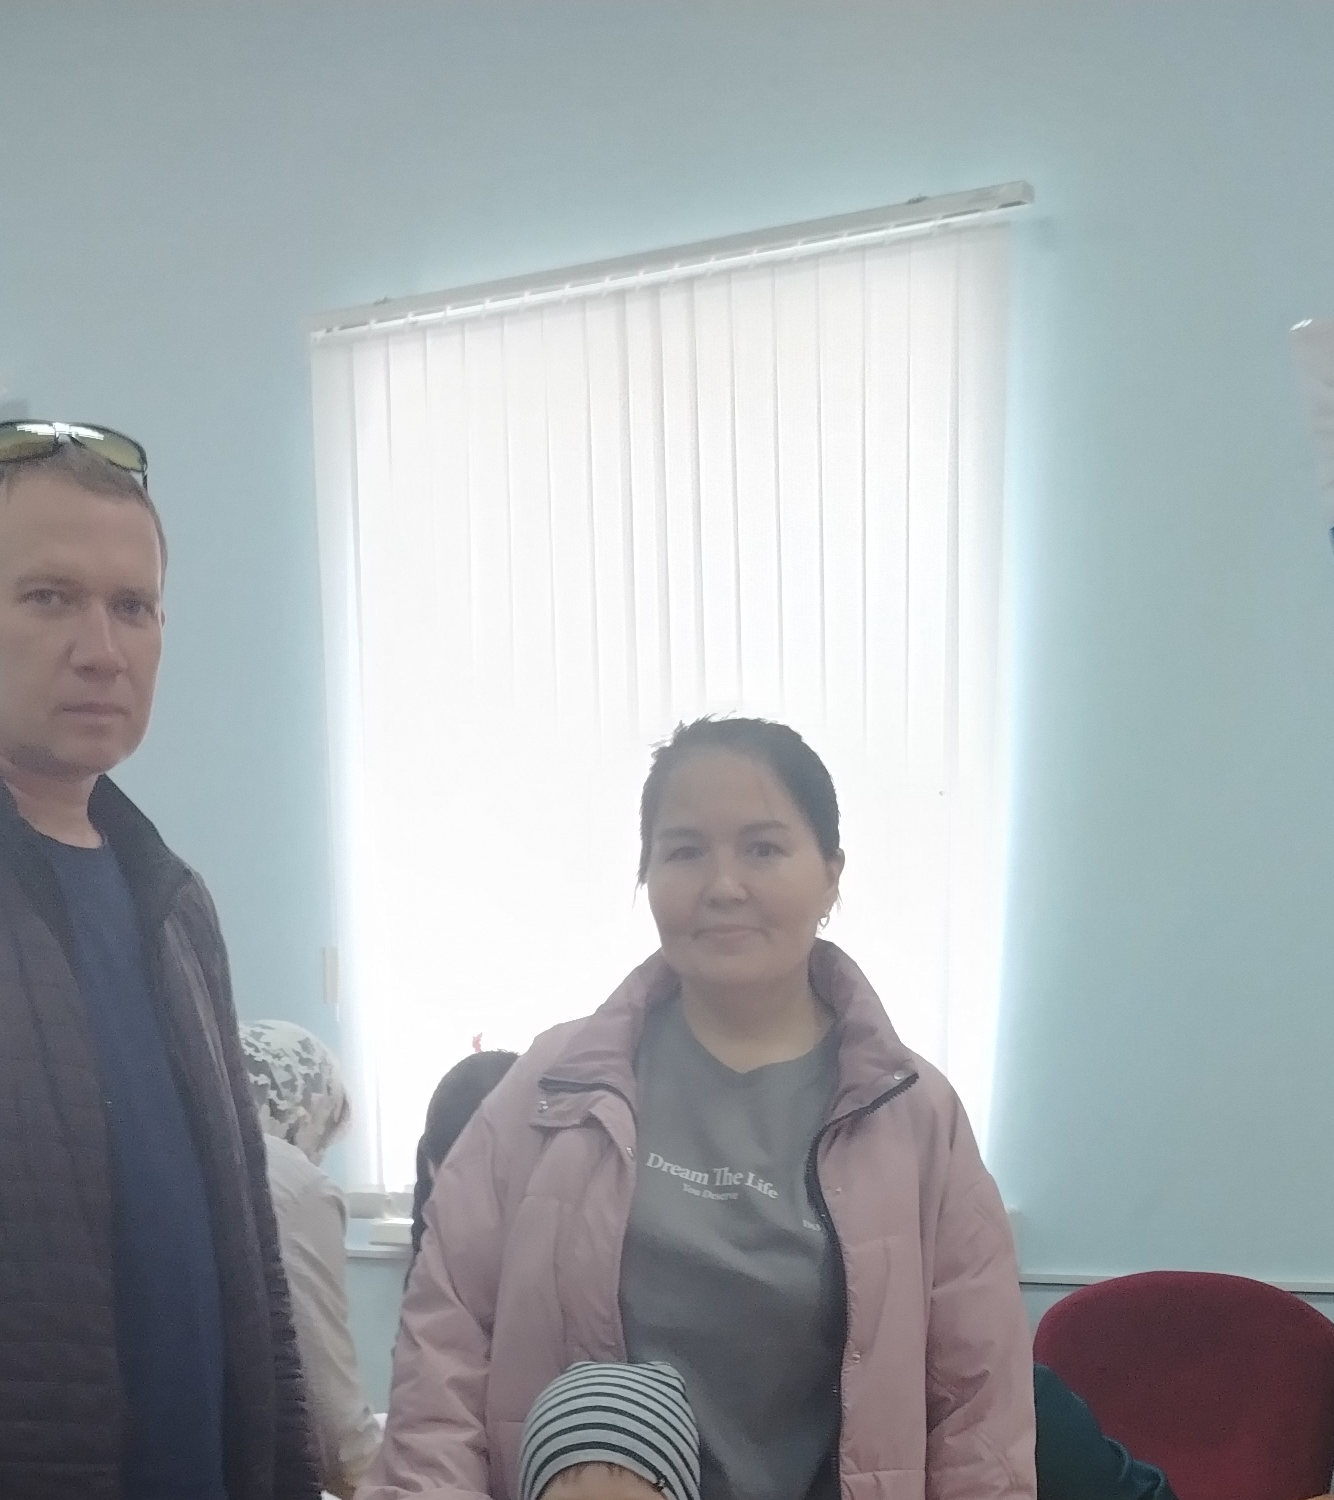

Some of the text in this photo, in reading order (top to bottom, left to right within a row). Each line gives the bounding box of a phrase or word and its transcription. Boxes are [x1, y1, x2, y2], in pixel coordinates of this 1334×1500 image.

[645, 1152, 779, 1199] Dream The Life
